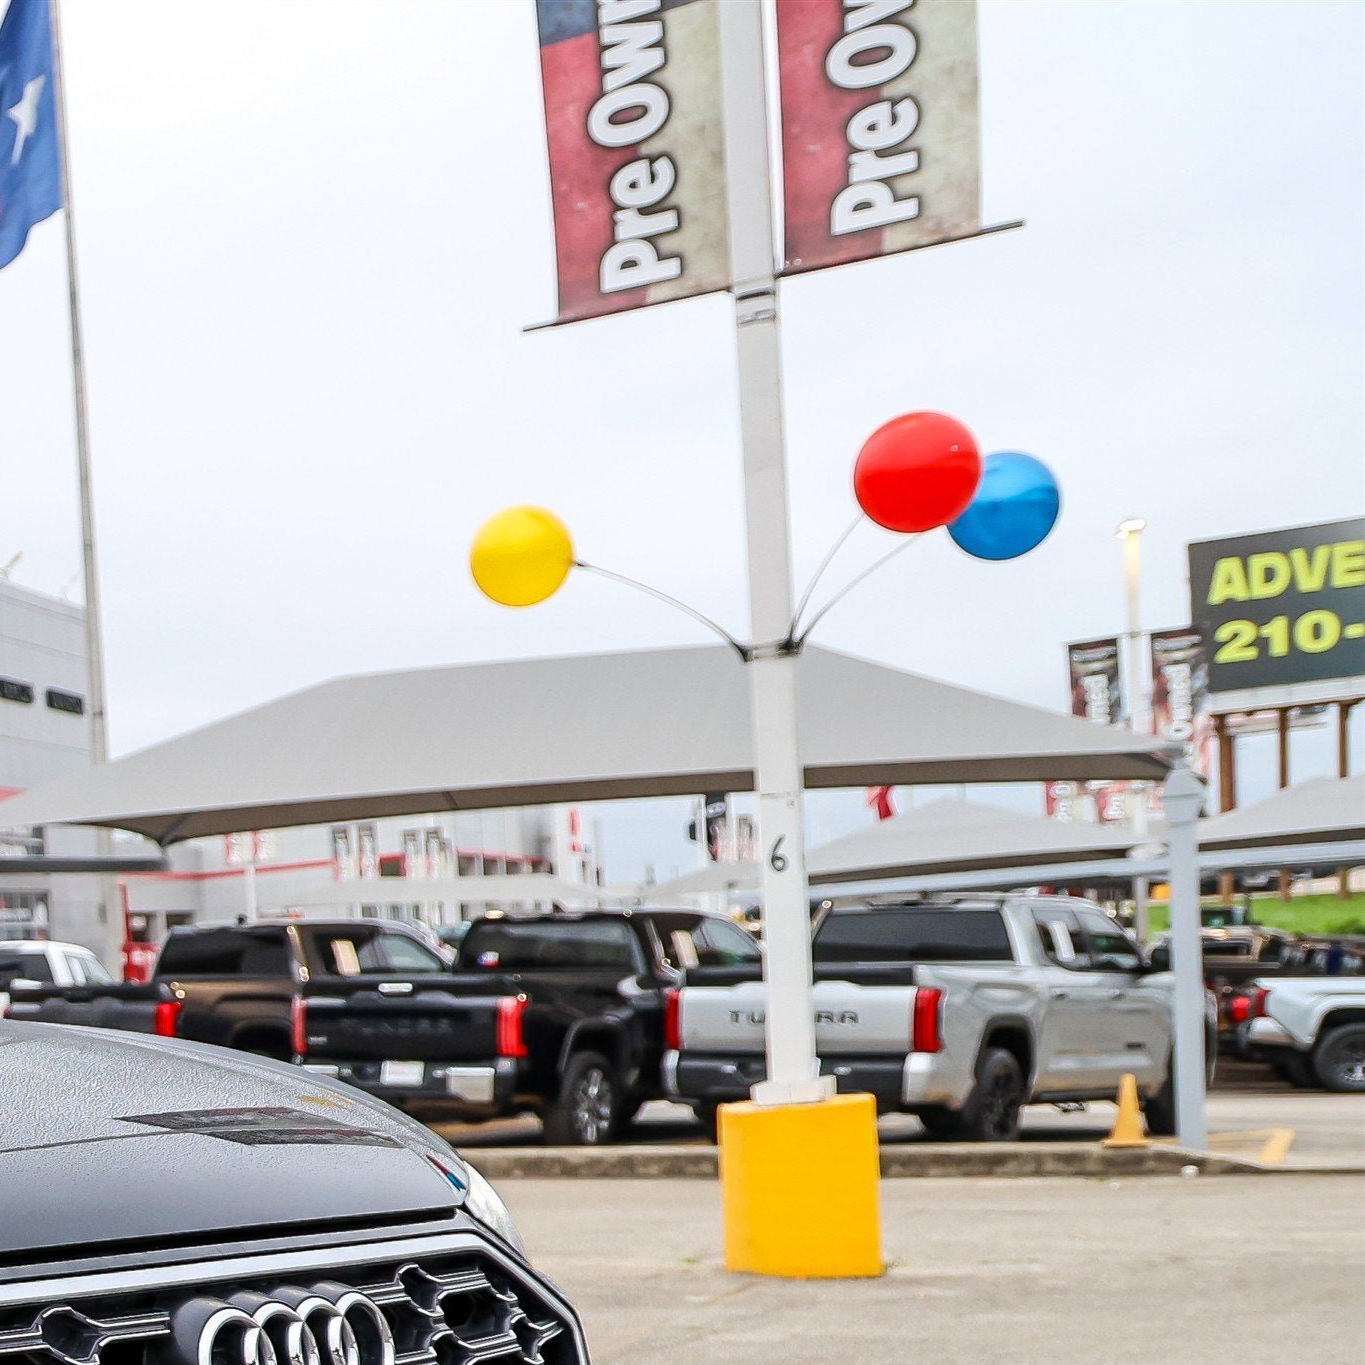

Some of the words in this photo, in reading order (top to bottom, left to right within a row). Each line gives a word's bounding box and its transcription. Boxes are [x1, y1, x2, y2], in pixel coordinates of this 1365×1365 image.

[830, 97, 919, 236] Pre
[599, 155, 682, 293] Pre
[1206, 540, 1365, 605] ADVE
[1213, 609, 1365, 664] 210-
[770, 835, 787, 872] 6
